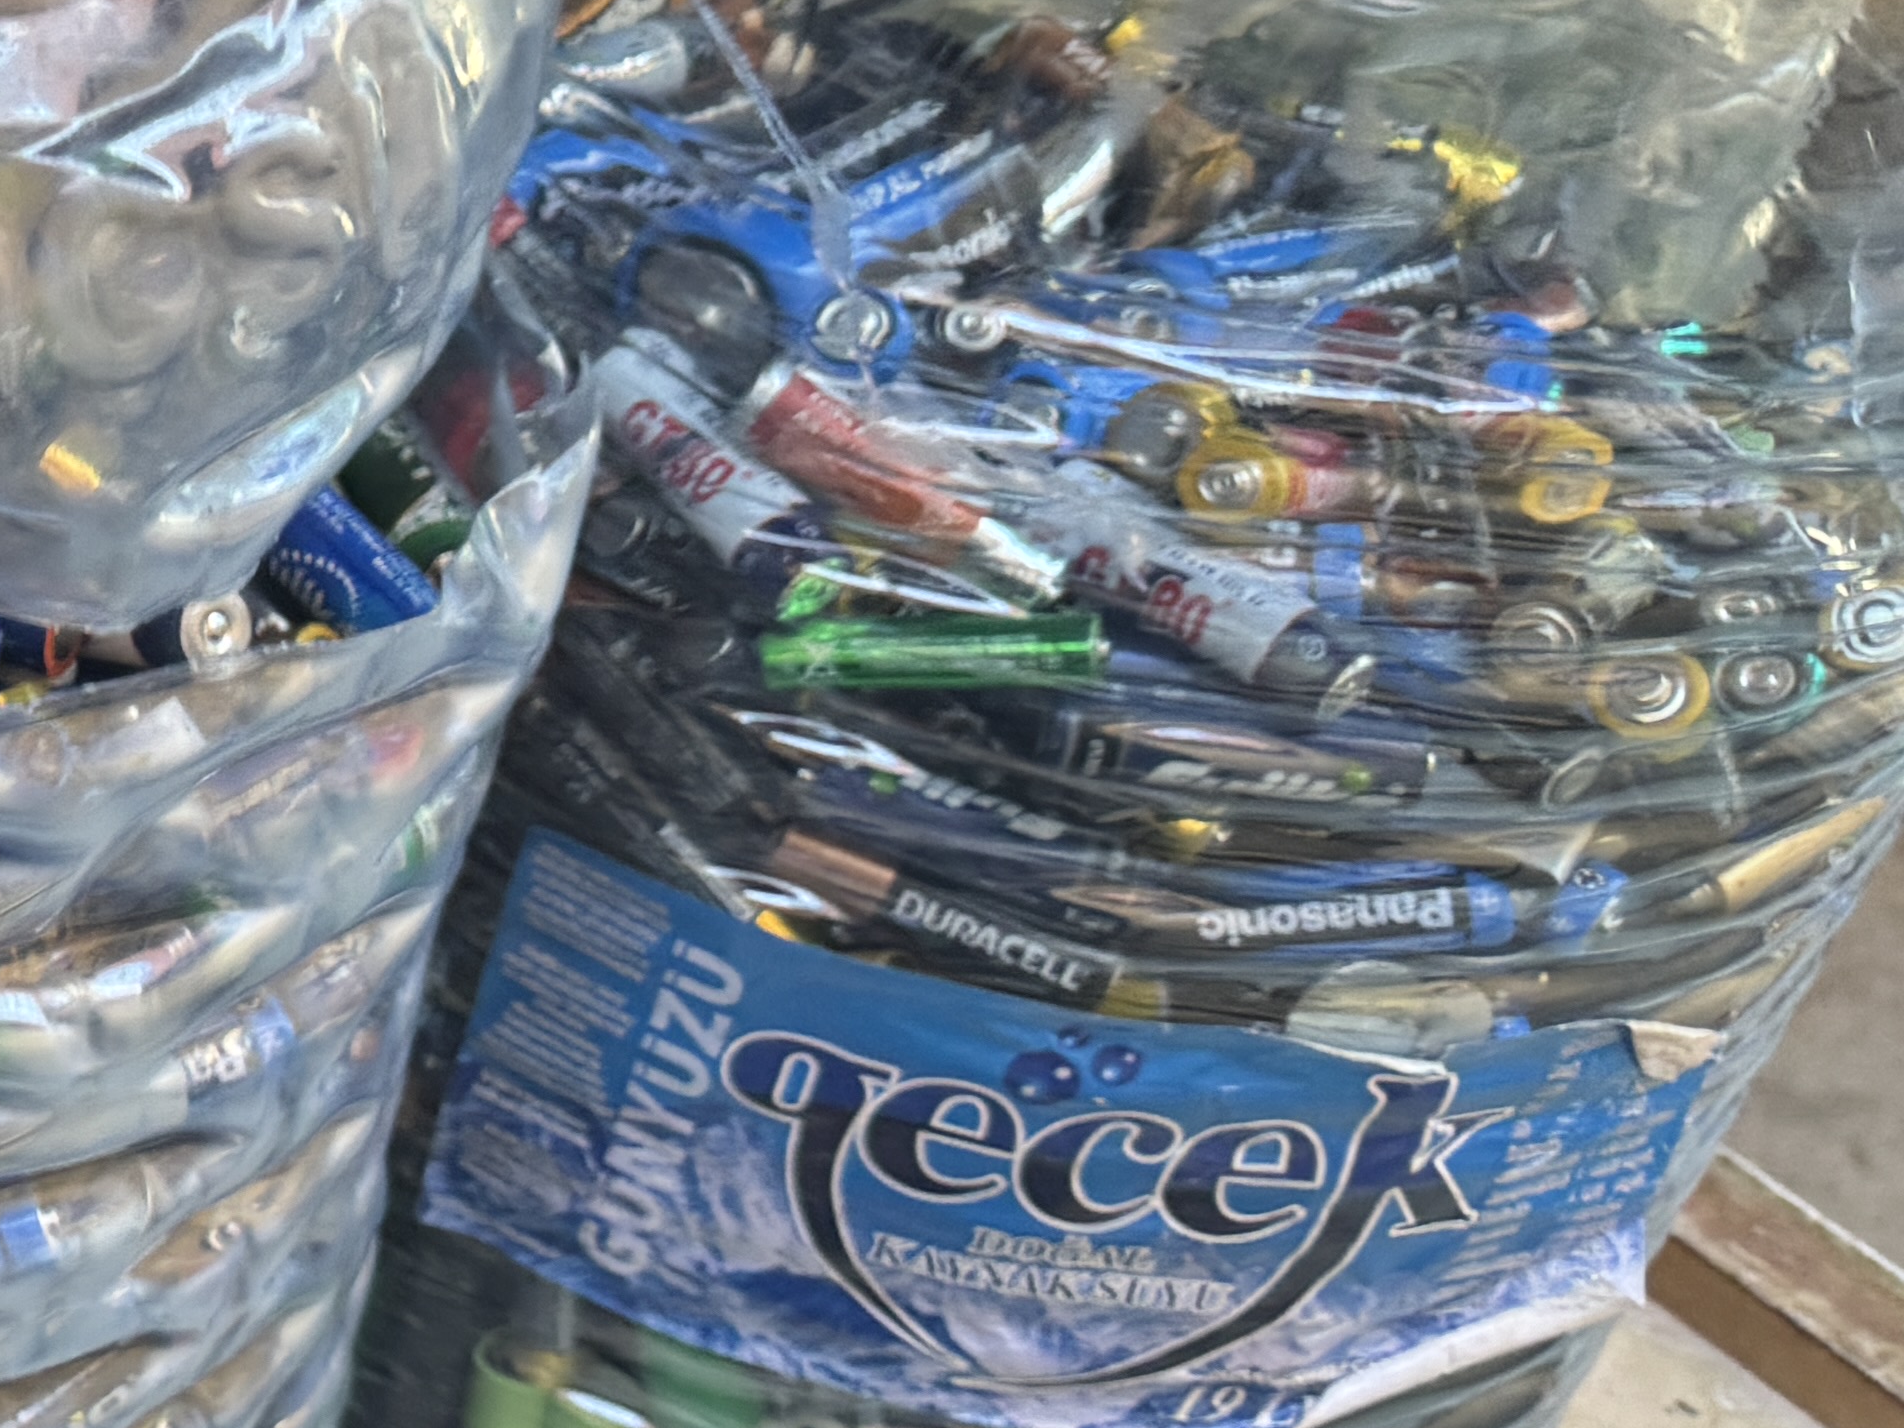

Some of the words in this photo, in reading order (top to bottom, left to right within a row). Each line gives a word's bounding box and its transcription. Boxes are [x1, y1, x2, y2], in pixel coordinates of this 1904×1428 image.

[894, 888, 1091, 990] DURACELL
[1197, 887, 1456, 947] Panasonic
[578, 941, 743, 1275] GÜNYÜZÜ
[868, 1230, 1085, 1309] KAYNAK
[1095, 1273, 1235, 1316] SUYU
